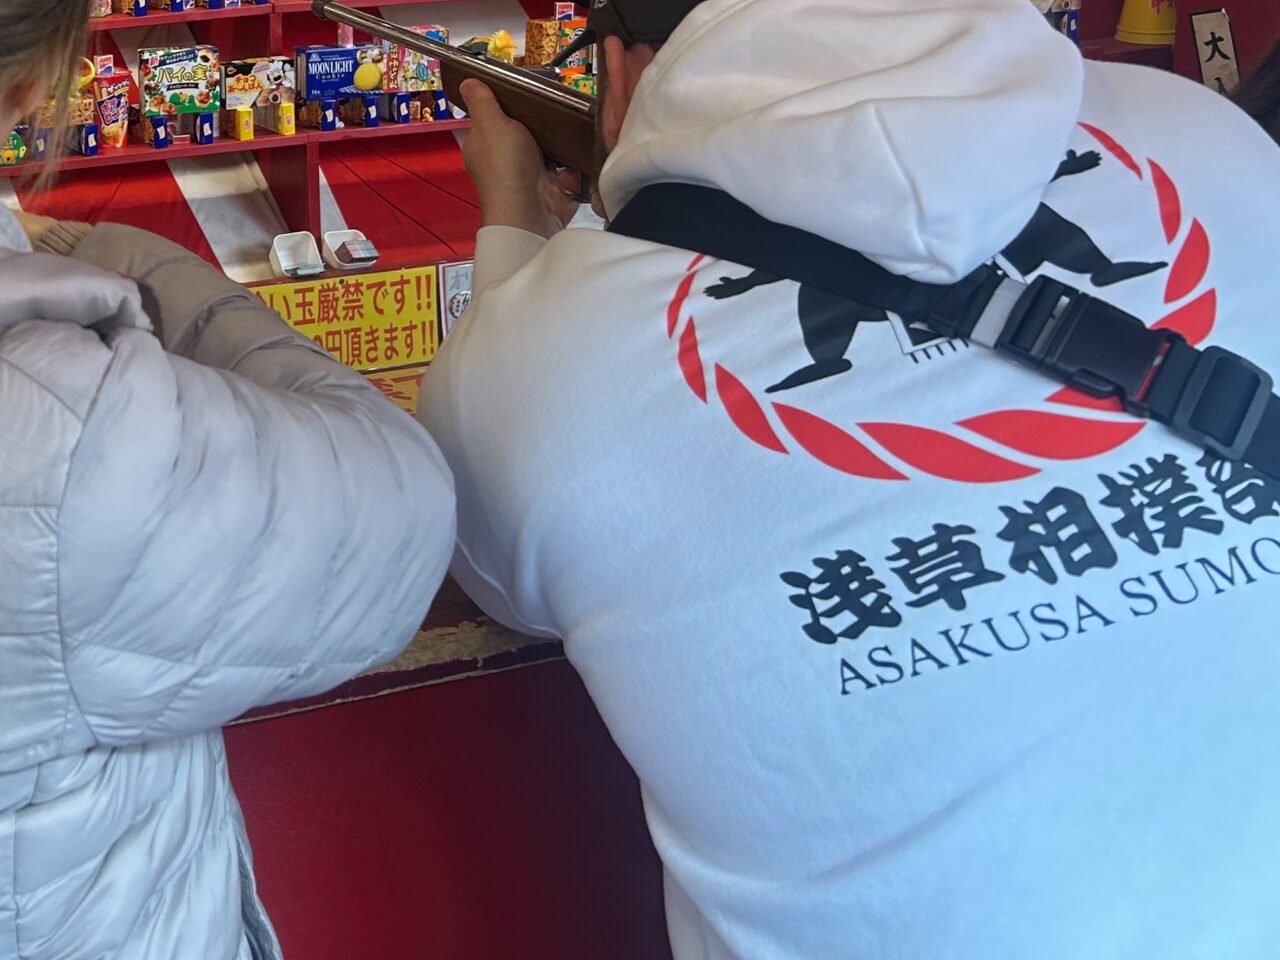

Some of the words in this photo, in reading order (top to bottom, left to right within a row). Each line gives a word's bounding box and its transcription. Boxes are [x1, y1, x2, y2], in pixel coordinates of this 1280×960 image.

[157, 65, 208, 83] パイの実
[234, 74, 259, 85] チョコ
[307, 59, 354, 75] MOONLIGHT
[256, 274, 432, 327] い玉厳禁です!!
[314, 320, 435, 366] 円頂きます!!
[839, 594, 1115, 696] ASAKUSA
